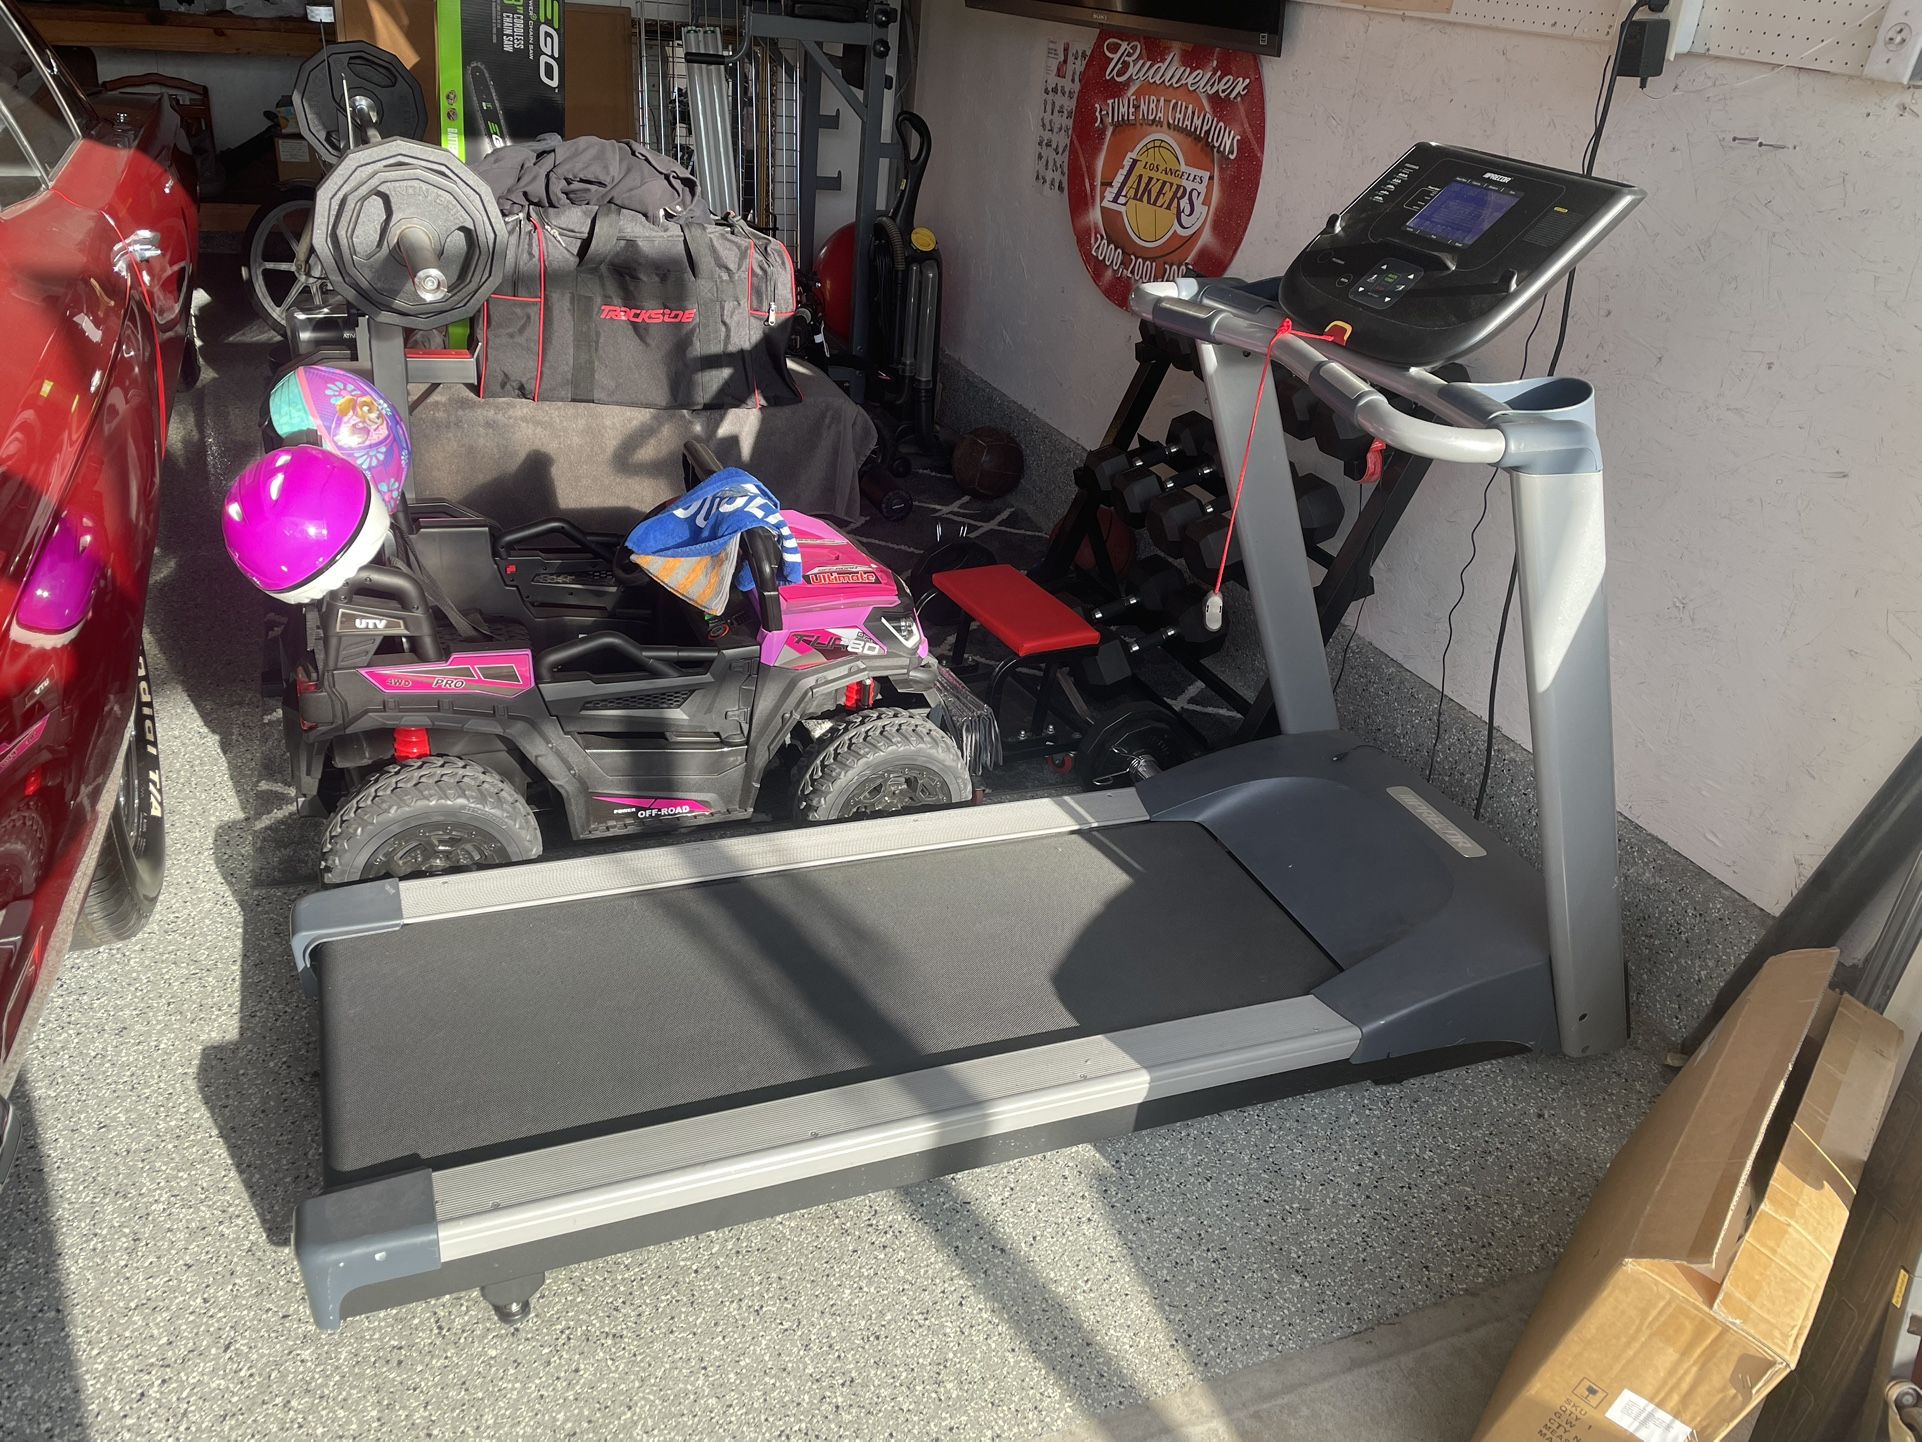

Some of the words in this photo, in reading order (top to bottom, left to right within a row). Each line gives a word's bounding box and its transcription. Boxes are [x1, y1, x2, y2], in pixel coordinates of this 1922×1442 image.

[503, 12, 513, 34] CHAIN
[513, 14, 524, 49] CORDLESS
[503, 34, 514, 52] SAW
[1103, 38, 1251, 102] Budweiser
[1095, 95, 1137, 127] 3-TIME
[1140, 95, 1165, 122] NBA
[1168, 99, 1241, 160] CHAMPIONS
[1142, 161, 1161, 173] LOS
[1161, 168, 1205, 185] ANGELES
[1485, 172, 1512, 183] PRECOR
[1107, 157, 1203, 230] LAKERS
[1091, 233, 1123, 277] 2000,
[1163, 263, 1194, 281] 200
[354, 618, 387, 629] UTV
[386, 678, 412, 687] 4WD
[432, 677, 466, 689] PRO
[137, 646, 159, 756] adial
[148, 769, 163, 818] T/A
[637, 805, 690, 818] OFF-ROAD
[1559, 1405, 1581, 1422] QTY
[1564, 1398, 1588, 1416] SKU
